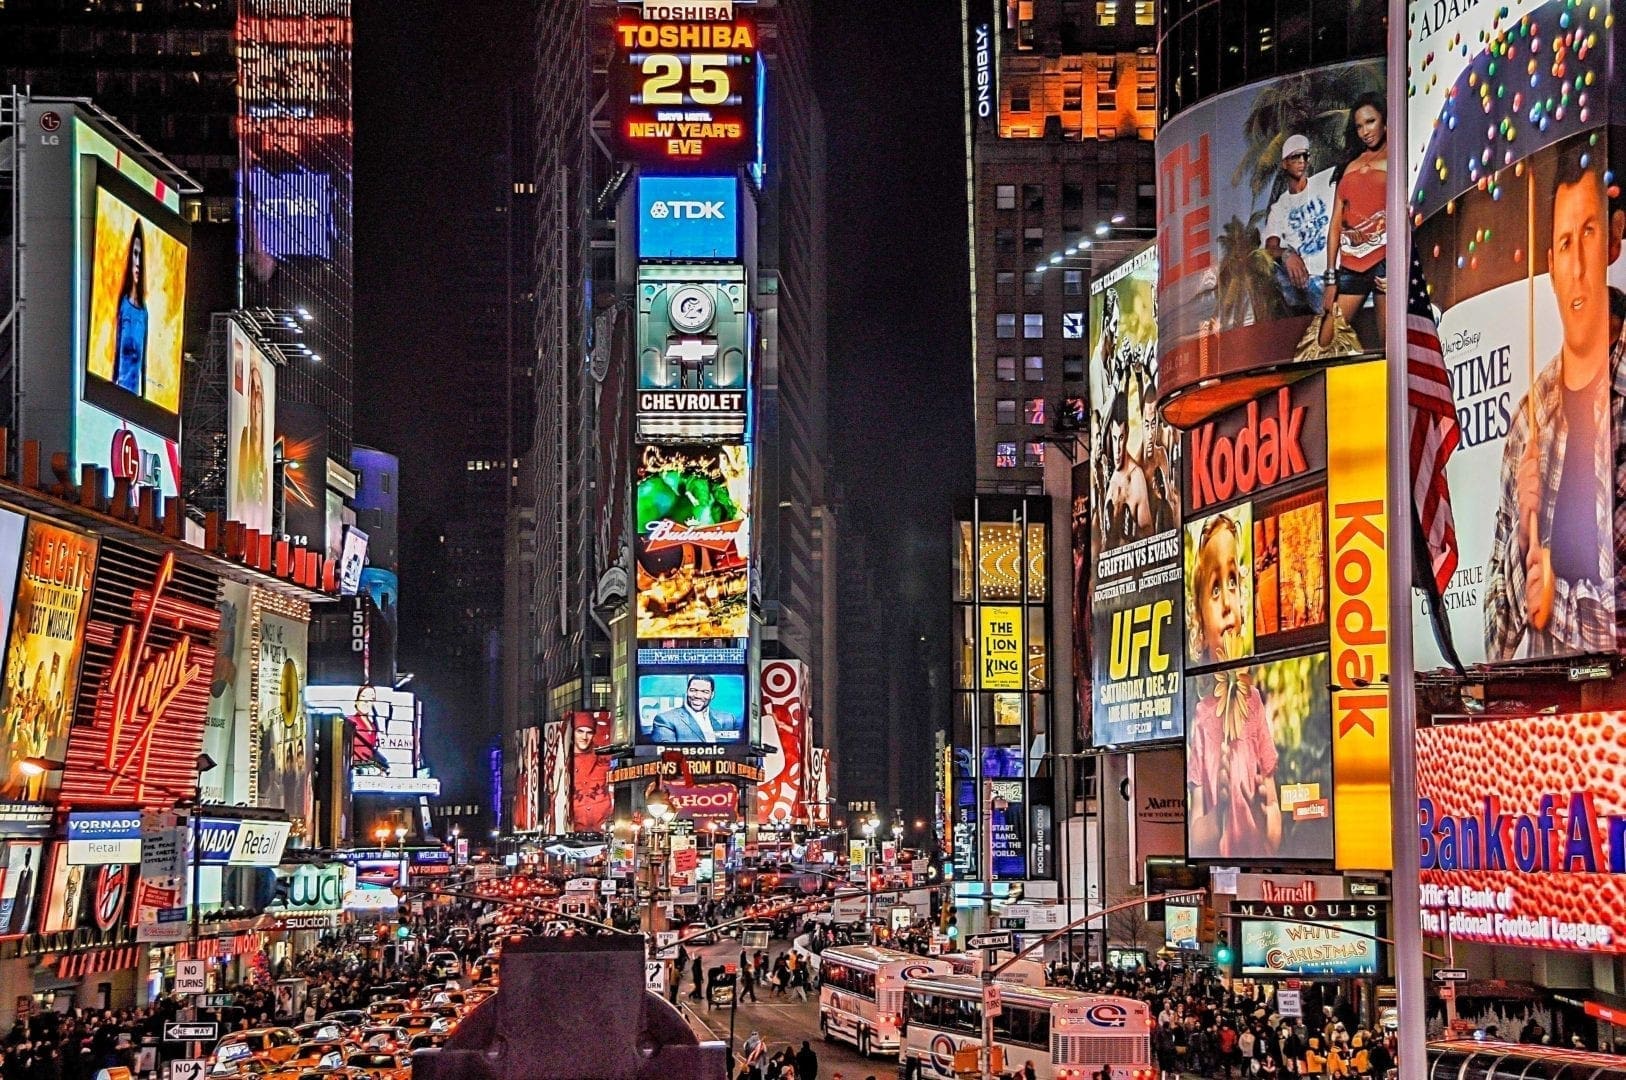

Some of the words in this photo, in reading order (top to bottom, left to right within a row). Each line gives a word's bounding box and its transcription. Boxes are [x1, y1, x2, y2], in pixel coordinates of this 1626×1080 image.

[646, 7, 731, 20] TOSHIBA
[618, 25, 753, 48] TOSHIBA
[642, 54, 730, 105] 25
[629, 122, 673, 138] NEW
[679, 122, 741, 138] YEAR'S
[41, 135, 60, 146] LG
[668, 139, 703, 155] EVE
[667, 201, 725, 219] TDK
[641, 393, 742, 410] CHEVROLET
[1192, 387, 1308, 510] Kodak
[293, 535, 308, 546] 14
[29, 531, 93, 592] HEIGHTS
[1098, 551, 1135, 579] GRIFFIN
[1135, 547, 1147, 567] VS
[1147, 536, 1179, 564] EVANS
[1456, 566, 1483, 588] TRUE
[29, 604, 47, 634] BEST
[47, 609, 74, 642] MUSICAL
[352, 597, 363, 652] 1500
[990, 622, 1012, 633] THE
[1334, 499, 1388, 739] Kodak
[987, 636, 1017, 656] LION
[1109, 599, 1173, 681] UFC
[986, 657, 1018, 678] KING
[104, 552, 200, 803] Virgin
[1101, 678, 1146, 706] SATURDAY,
[1146, 674, 1167, 698] DEC.
[1167, 671, 1179, 694] 27
[69, 819, 141, 830] VORNADO
[1419, 794, 1508, 872] Bank
[1514, 793, 1555, 873] of
[88, 842, 121, 854] Retail
[241, 830, 280, 855] Retail
[1462, 886, 1494, 907] Bank
[1496, 887, 1513, 911] of
[1241, 904, 1377, 918] MARQUIS
[285, 916, 330, 929] swatch
[1008, 920, 1017, 929] 46
[1494, 912, 1549, 942] Football
[1550, 916, 1610, 946] League
[991, 936, 1006, 944] WAY
[1285, 925, 1341, 942] WHITE
[1267, 940, 1367, 969] CHRISTMAS
[184, 966, 197, 975] NO
[177, 979, 204, 988] TURNS
[988, 989, 997, 998] NO
[175, 1063, 191, 1073] NO
